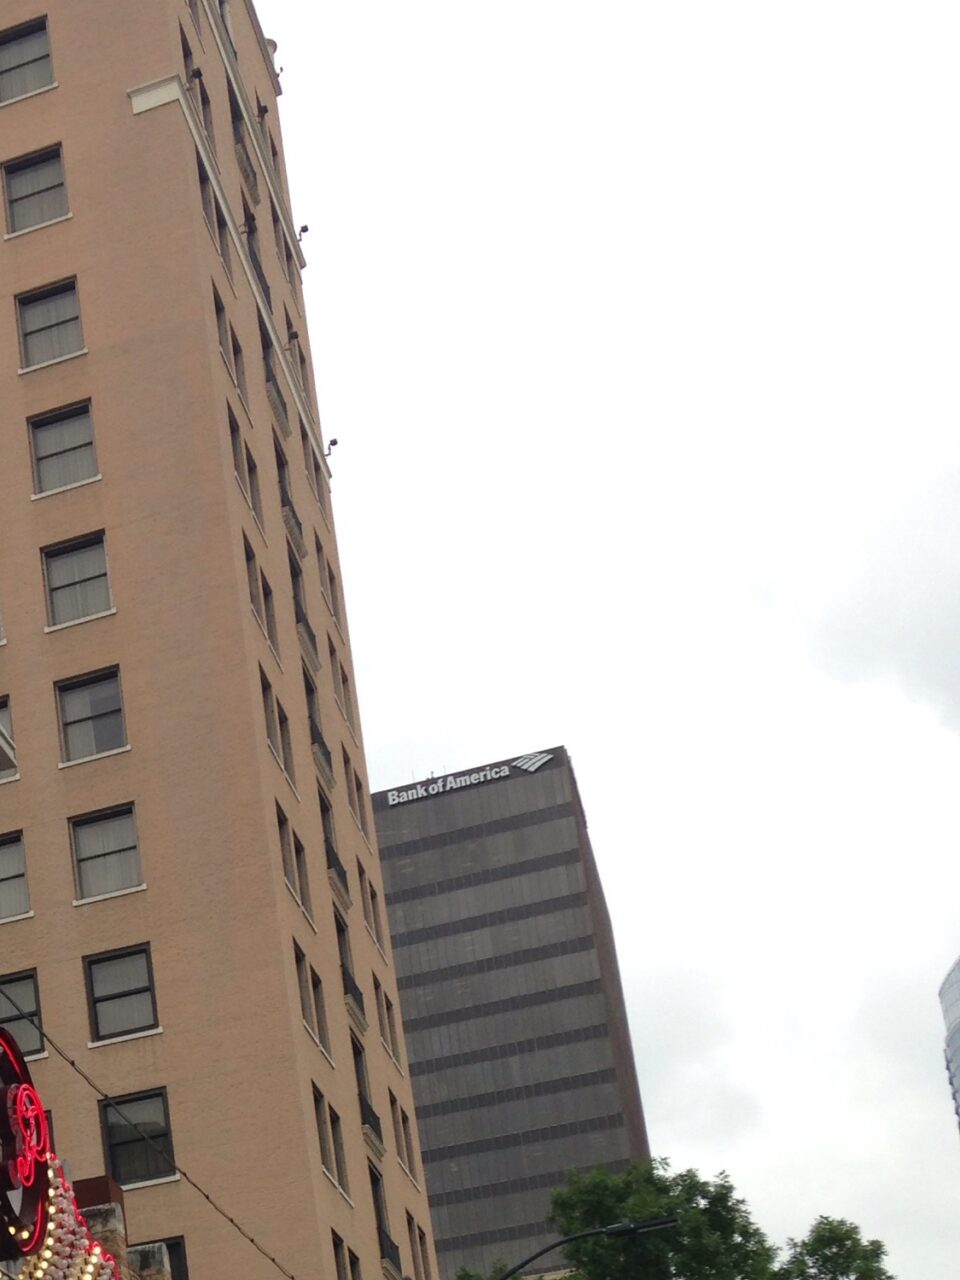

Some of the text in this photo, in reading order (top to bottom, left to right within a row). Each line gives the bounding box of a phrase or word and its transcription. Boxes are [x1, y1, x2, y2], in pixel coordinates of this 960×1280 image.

[387, 765, 510, 805] Bank of America
